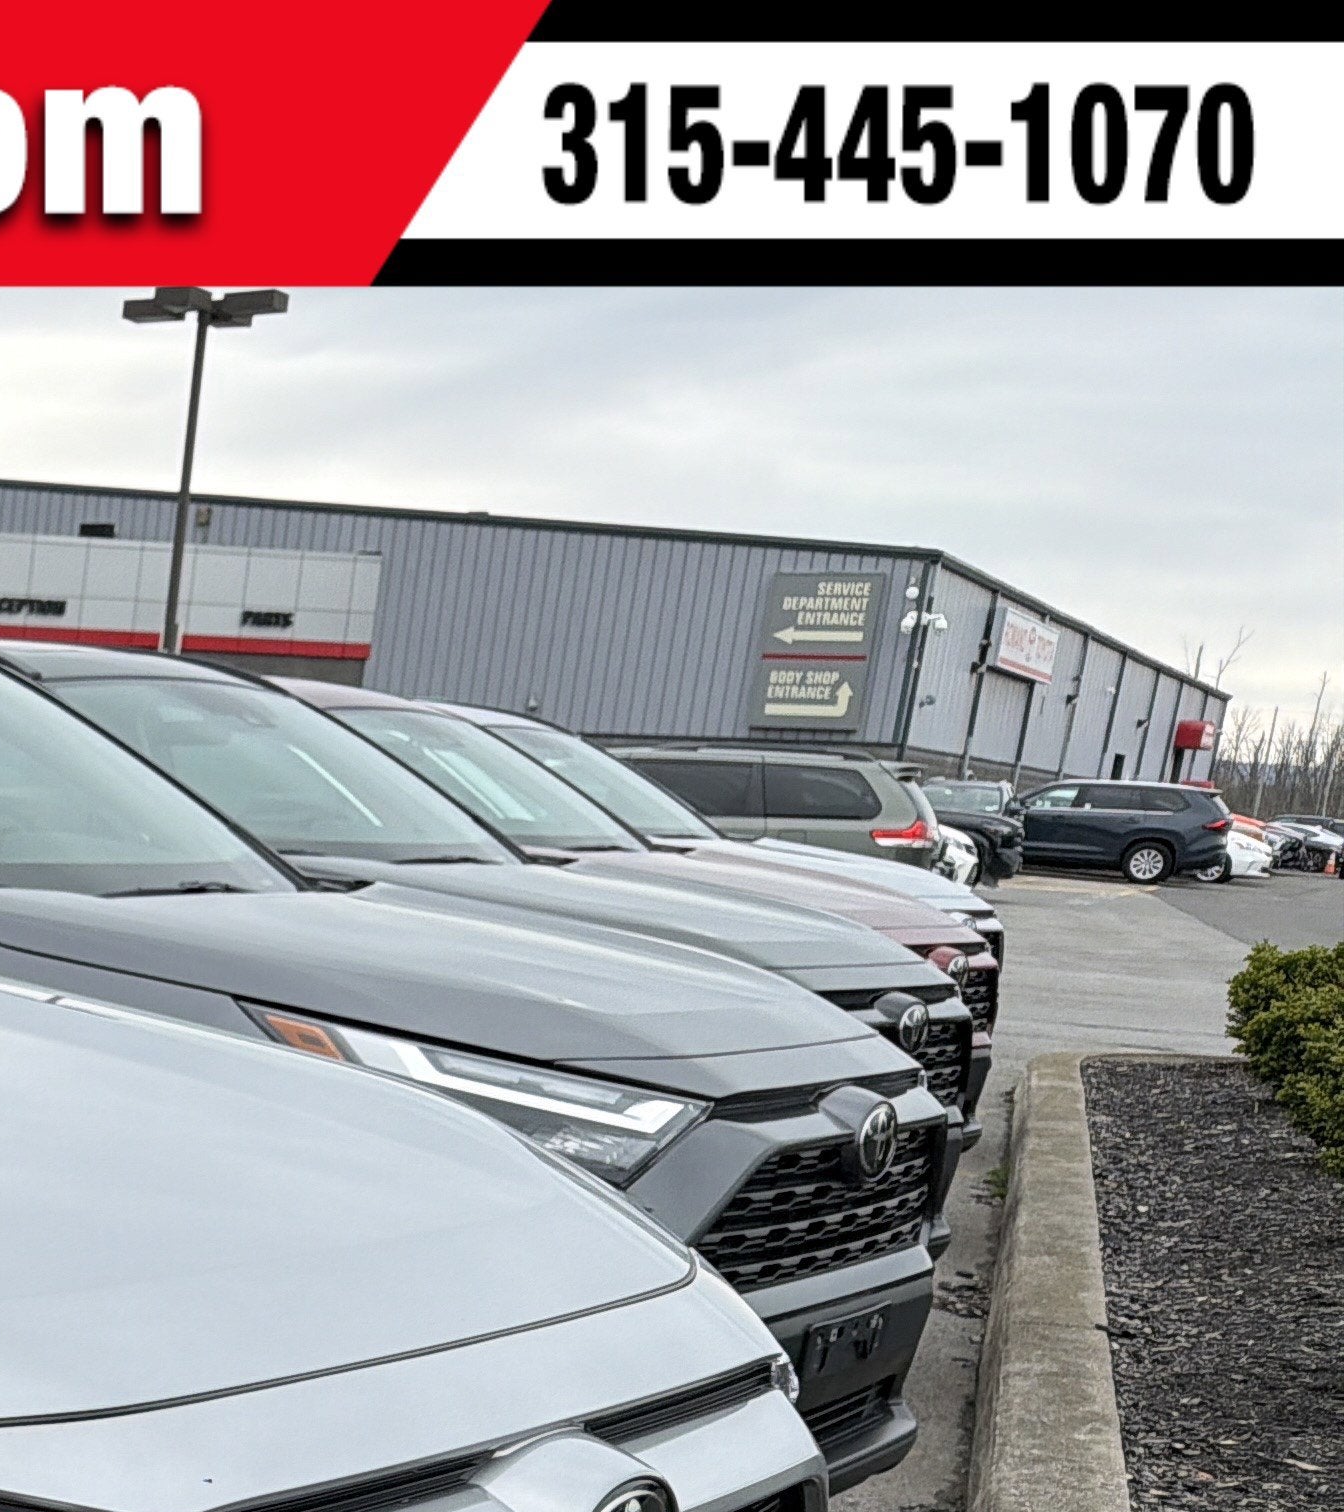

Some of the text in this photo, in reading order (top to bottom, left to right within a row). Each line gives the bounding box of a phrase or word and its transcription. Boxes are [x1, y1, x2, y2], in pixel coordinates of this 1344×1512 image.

[817, 581, 872, 597] SERVICE
[782, 596, 870, 611] DEPARTMENT
[797, 611, 866, 627] ENTRANCE
[769, 670, 840, 685] BODY SHOP
[766, 685, 832, 700] ENTRANCE
